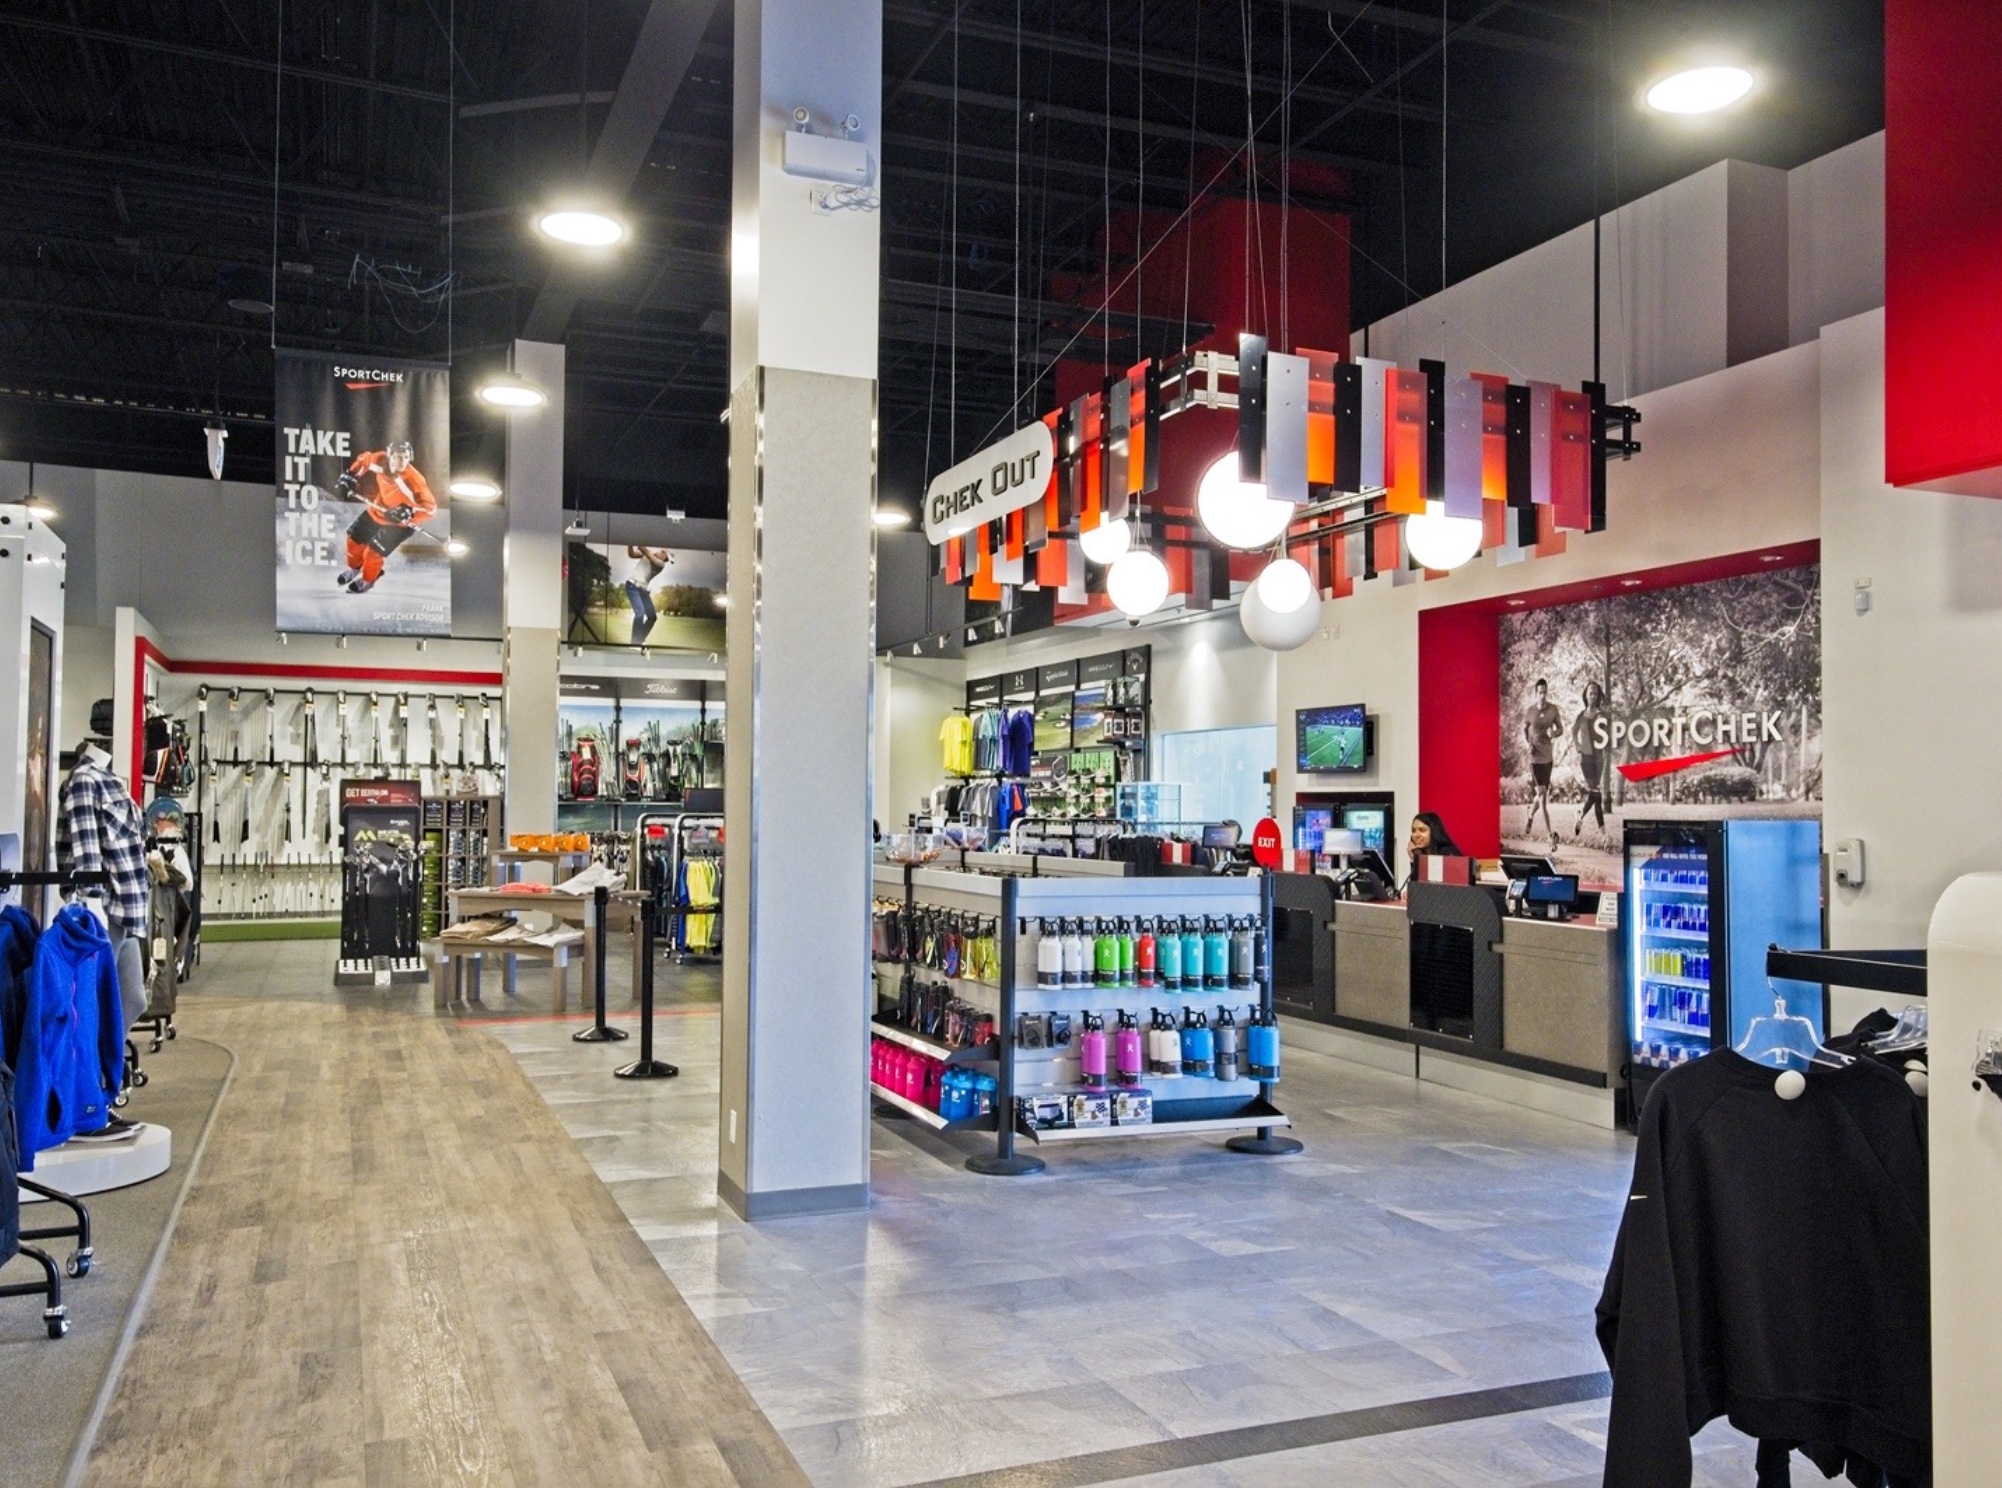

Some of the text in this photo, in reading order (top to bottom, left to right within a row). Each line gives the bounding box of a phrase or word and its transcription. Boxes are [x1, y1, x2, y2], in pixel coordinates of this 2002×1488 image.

[333, 366, 404, 383] SPORTCHEK
[283, 427, 351, 457] TAKE
[284, 456, 310, 482] IT
[284, 484, 319, 511] TO
[931, 450, 1041, 525] CHEK OUT
[284, 512, 336, 539] THE
[284, 541, 338, 566] ICE.
[373, 612, 395, 621] SPORT
[1593, 710, 1784, 750] SPORTCHEK
[1257, 836, 1276, 849] EXIT
